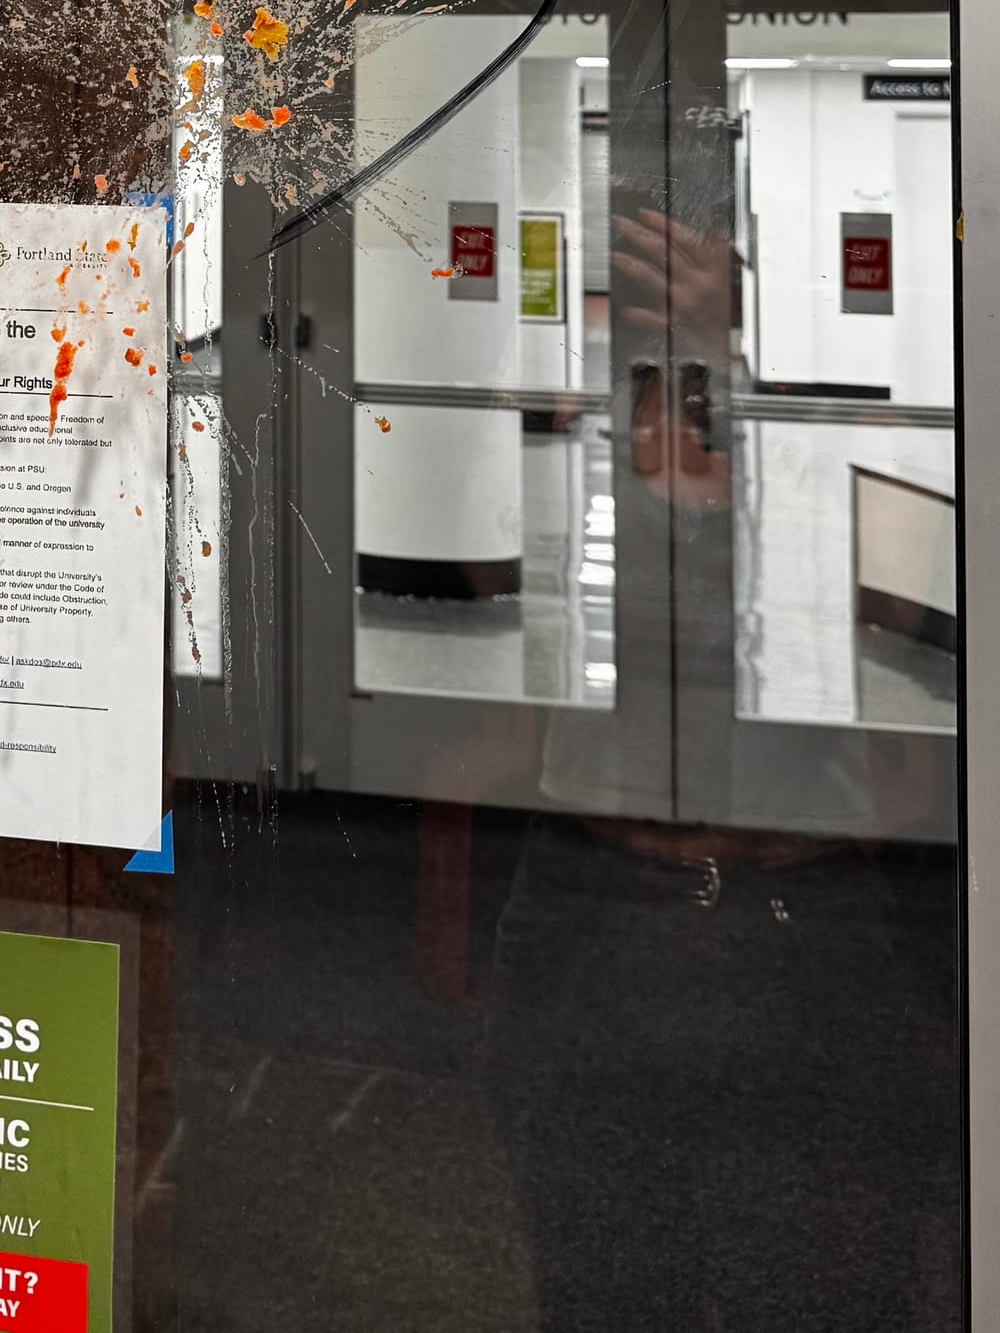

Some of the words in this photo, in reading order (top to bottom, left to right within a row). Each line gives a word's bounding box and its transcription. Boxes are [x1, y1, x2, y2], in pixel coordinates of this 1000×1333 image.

[16, 246, 72, 261] Portland
[6, 320, 36, 339] the
[13, 375, 52, 392] Rights
